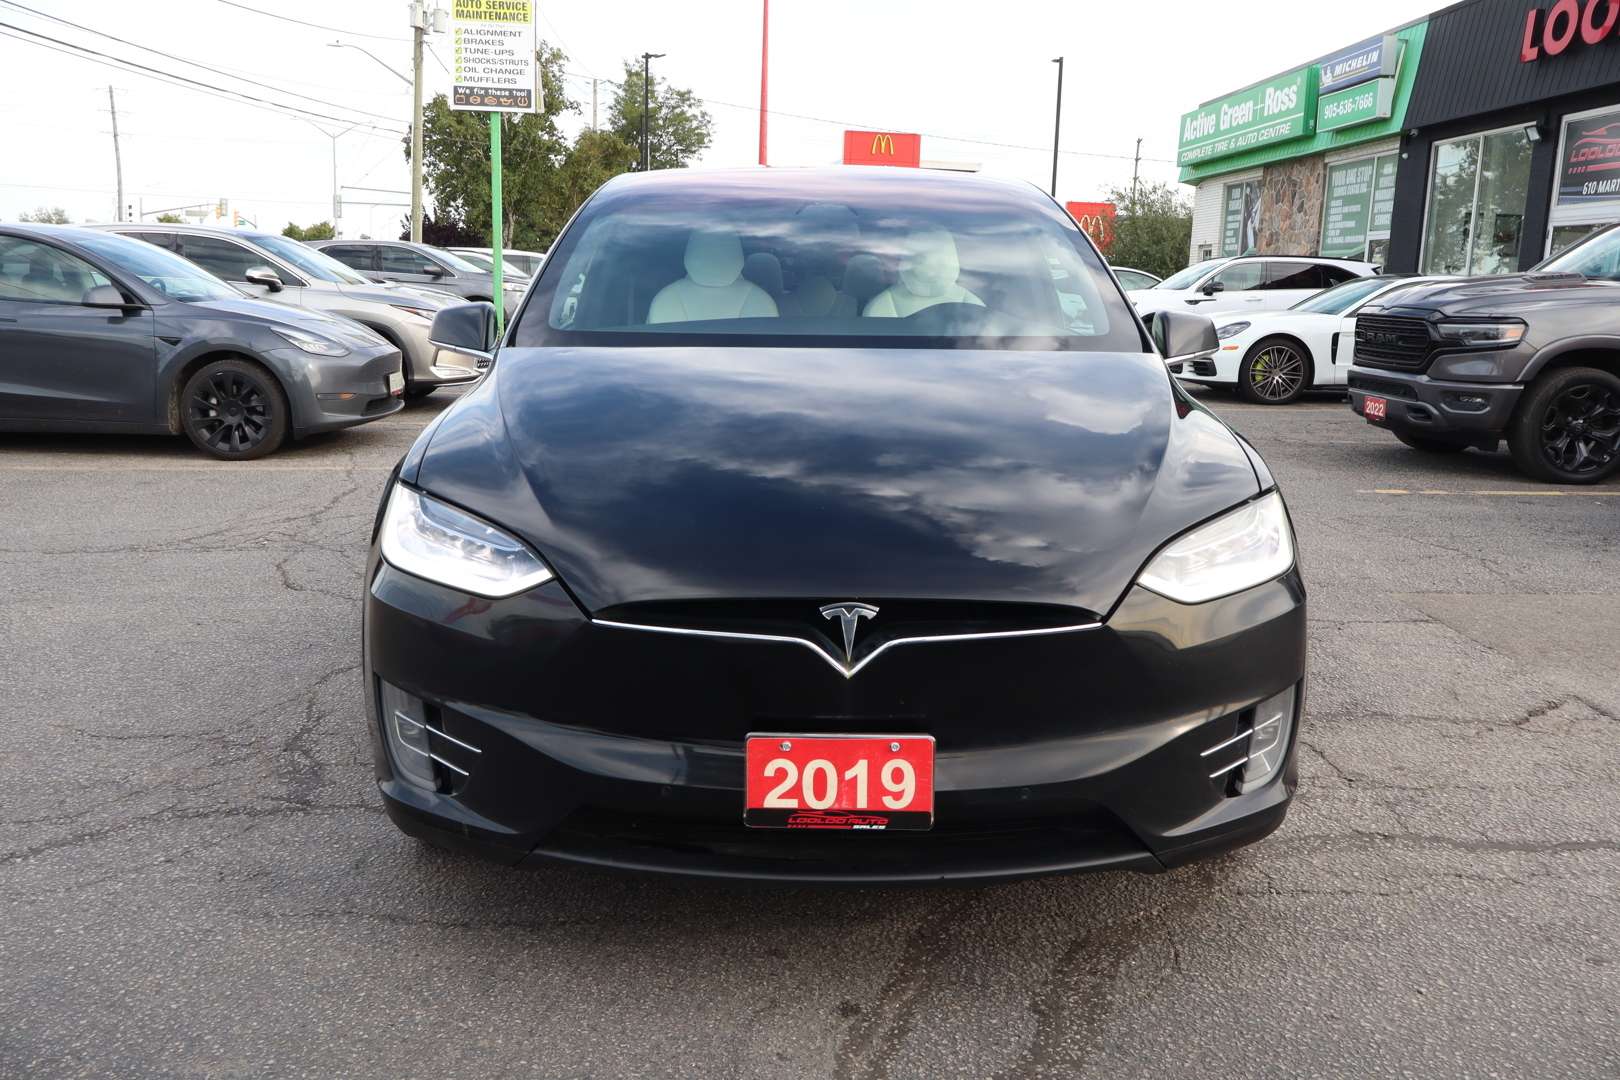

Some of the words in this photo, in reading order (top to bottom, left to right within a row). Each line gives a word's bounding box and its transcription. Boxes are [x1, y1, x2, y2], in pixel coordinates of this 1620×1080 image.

[455, 0, 482, 9] AUTO
[485, 0, 528, 11] SERVICE
[455, 9, 529, 22] MAINTENANCE
[463, 28, 522, 37] ALIGNMENT
[1520, 0, 1620, 63] LOO
[463, 38, 505, 46] BRAKES
[463, 47, 515, 56] TUNE-UPS
[1333, 50, 1380, 76] MICHELIN
[463, 66, 480, 74] OIL
[482, 67, 526, 76] CHANGE
[463, 76, 517, 85] MUFFLERS
[473, 87, 485, 95] fix
[1324, 92, 1374, 119] 905-636-7666
[1183, 112, 1216, 142] Active
[1181, 144, 1214, 162] COMPLETE
[1214, 141, 1228, 153] TIRE
[1229, 138, 1236, 149] &
[1236, 132, 1257, 147] AUTO
[1257, 122, 1292, 142] CENTRE
[1582, 181, 1597, 195] 610
[1367, 332, 1397, 344] RAM
[1366, 400, 1384, 417] 2022
[763, 758, 916, 810] 2019
